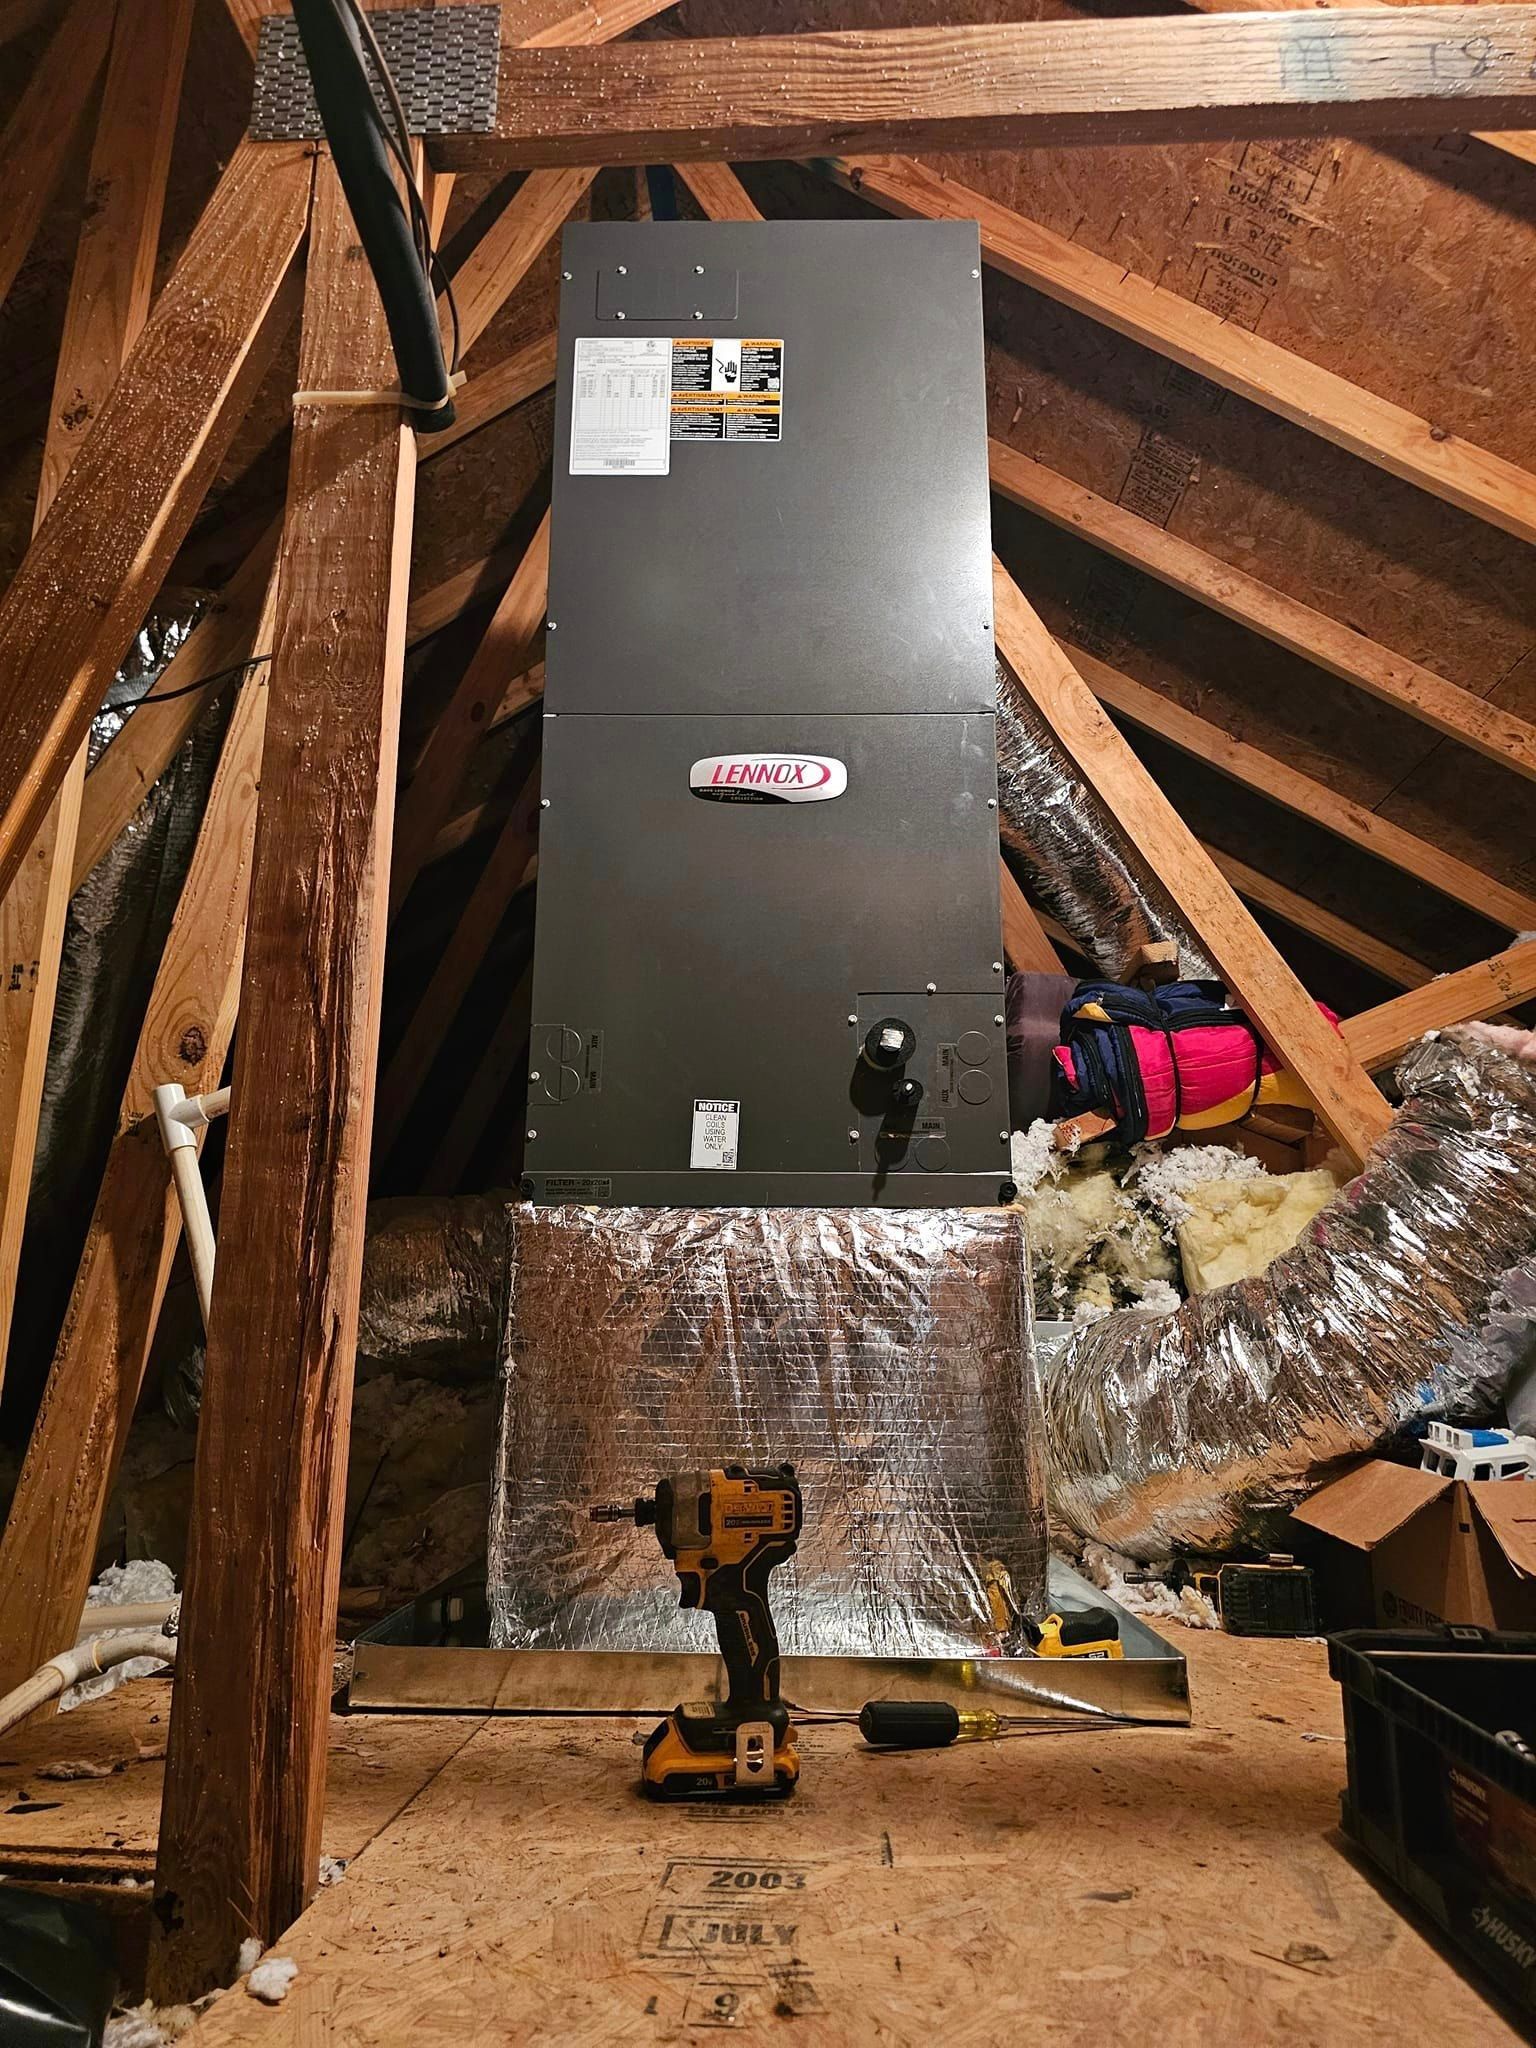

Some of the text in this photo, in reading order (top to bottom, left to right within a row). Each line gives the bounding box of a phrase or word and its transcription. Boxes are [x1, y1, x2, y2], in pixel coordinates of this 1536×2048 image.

[711, 763, 808, 785] LENNOX
[591, 1034, 599, 1049] AUX
[942, 1048, 950, 1066] MAIN
[589, 1071, 597, 1089] MAIN
[941, 1088, 949, 1103] AUX
[698, 1102, 735, 1112] NOTICE
[705, 1113, 727, 1121] CLEAN
[707, 1870, 808, 1890] 2003
[699, 1922, 800, 1946] JULY
[1484, 1917, 1536, 1969] HUSKY
